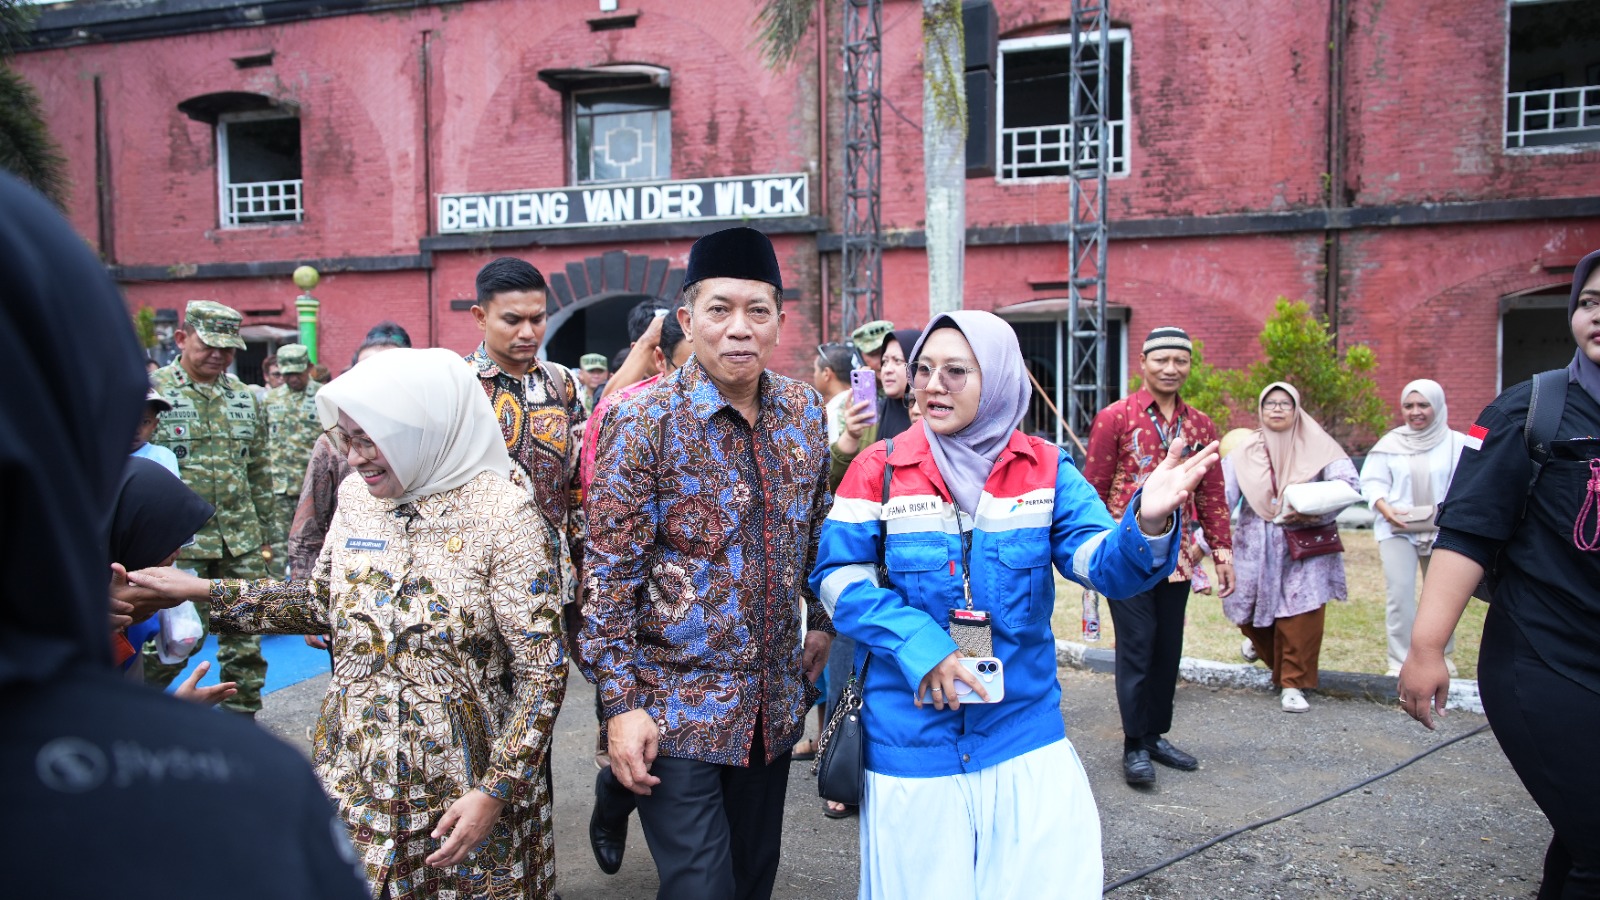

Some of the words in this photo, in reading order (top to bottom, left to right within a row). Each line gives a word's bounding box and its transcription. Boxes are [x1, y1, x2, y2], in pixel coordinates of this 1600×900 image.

[442, 191, 569, 230] BENTENG
[584, 187, 635, 222] VAN
[640, 184, 704, 219] DER
[714, 177, 804, 215] WIJCK
[229, 411, 243, 419] TNI
[246, 411, 256, 420] AD
[909, 501, 928, 512] RISKI
[930, 500, 936, 509] N
[1025, 498, 1054, 506] PERTAMIN
